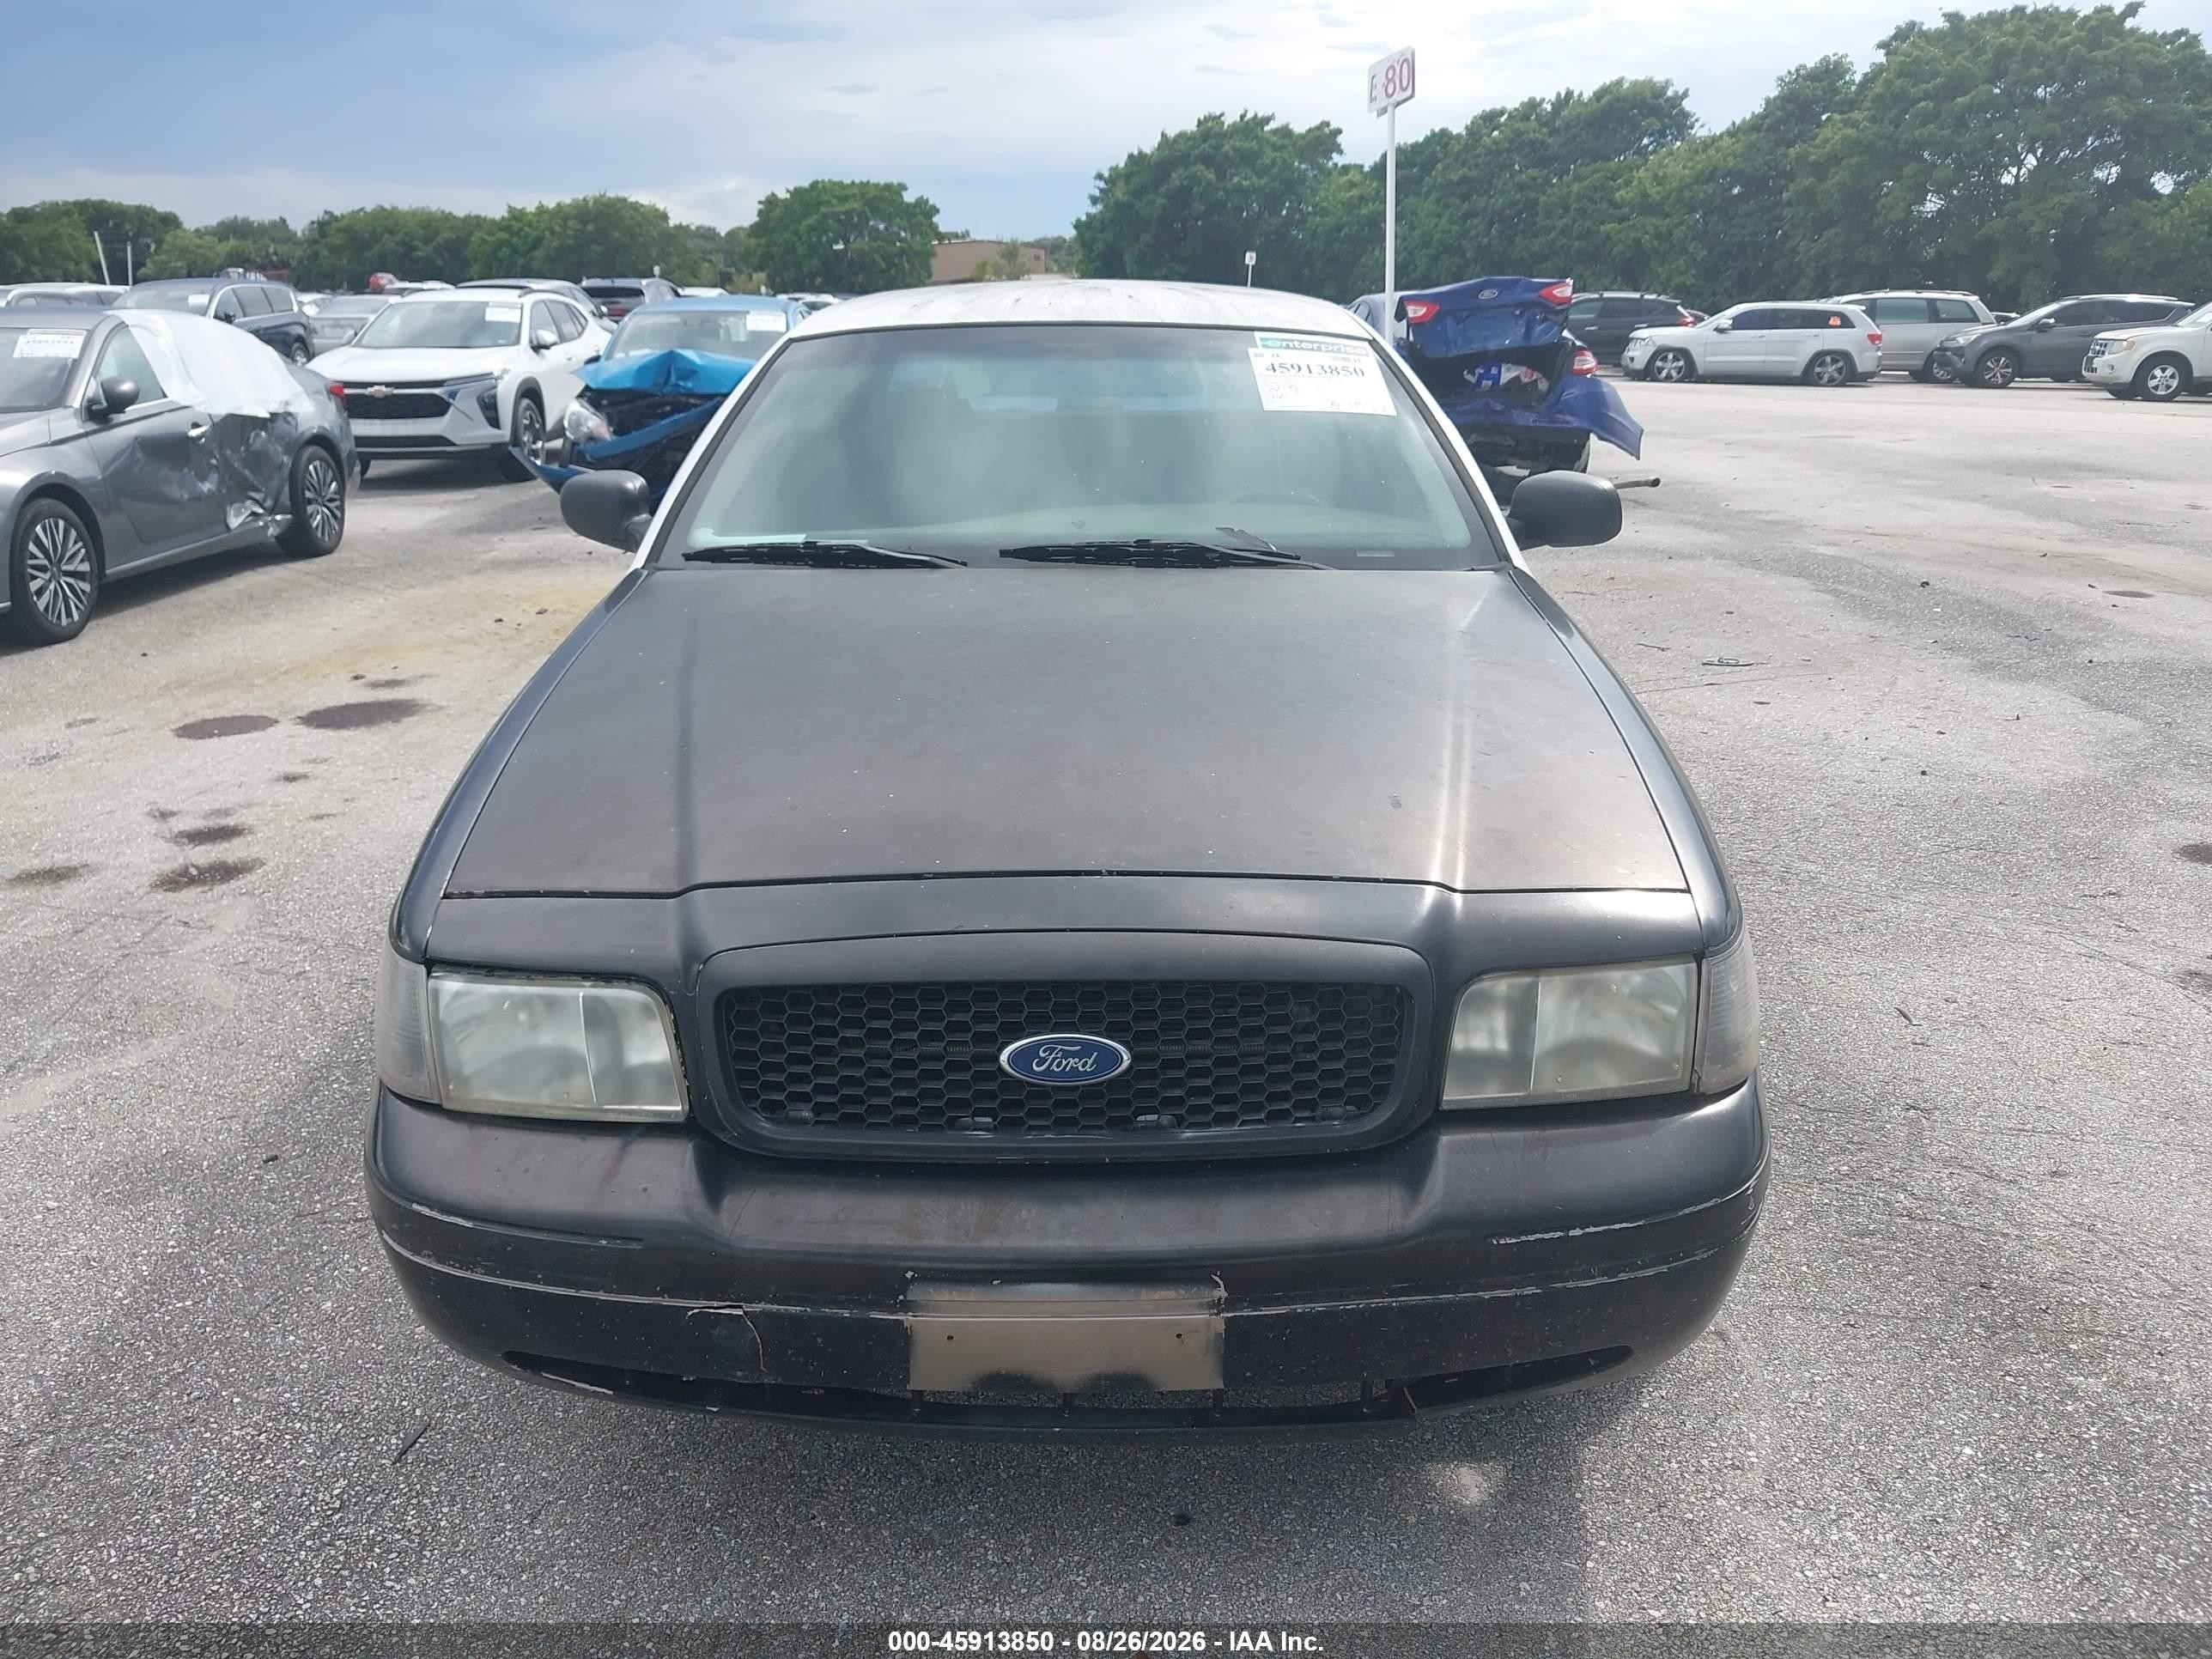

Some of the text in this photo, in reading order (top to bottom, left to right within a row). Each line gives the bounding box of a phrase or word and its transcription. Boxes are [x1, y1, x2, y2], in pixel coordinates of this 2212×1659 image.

[1384, 57, 1411, 99] 80
[1267, 338, 1367, 355] enterprise
[1265, 362, 1365, 378] 45913850
[1032, 1044, 1098, 1072] Ford
